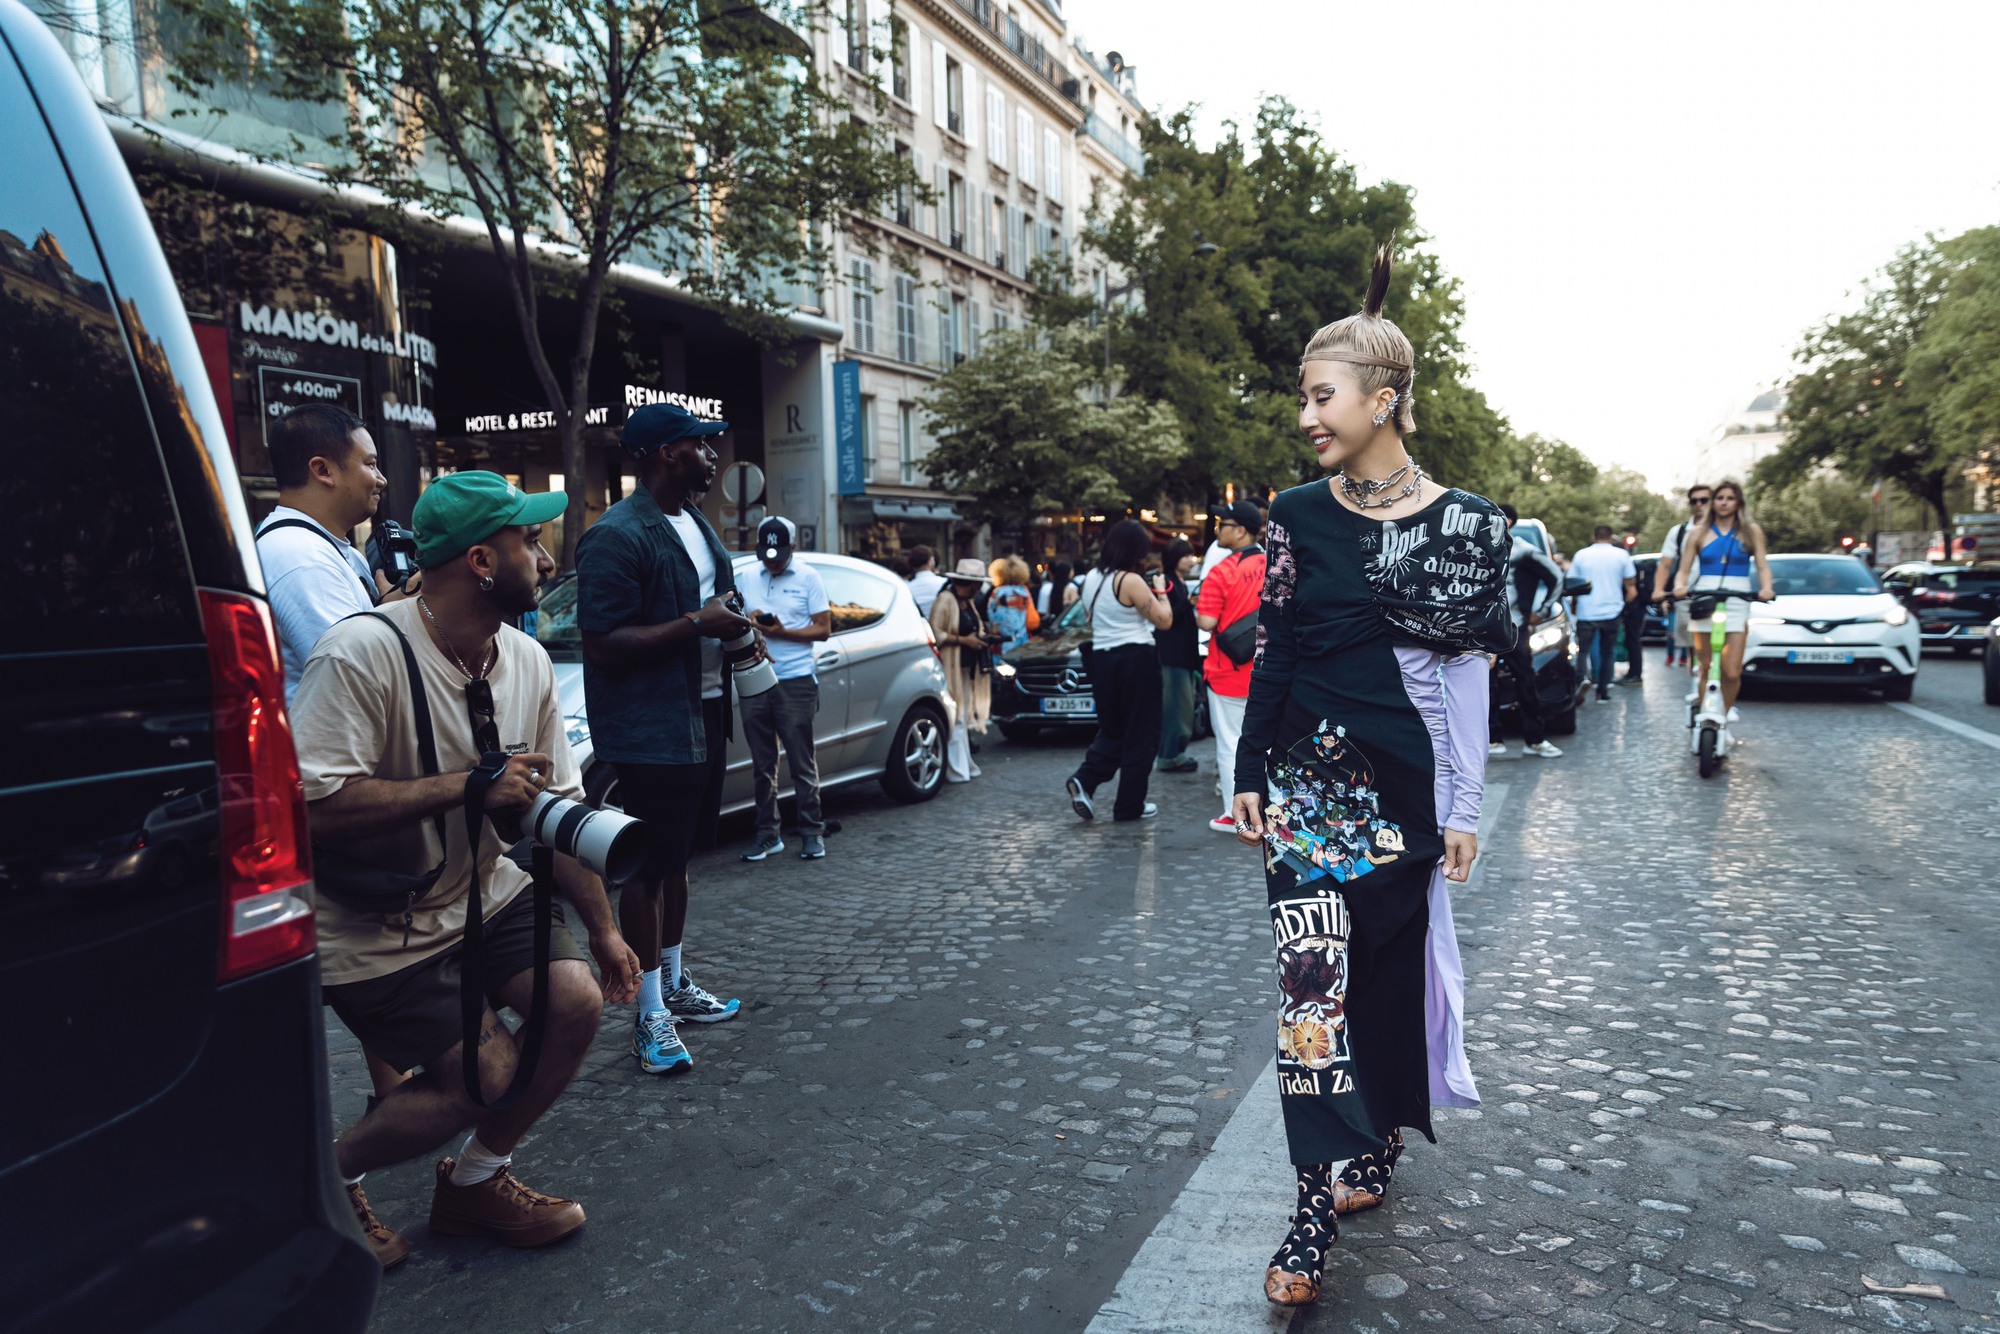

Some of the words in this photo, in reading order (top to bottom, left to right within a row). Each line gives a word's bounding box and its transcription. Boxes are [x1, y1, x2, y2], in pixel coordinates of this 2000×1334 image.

[240, 301, 359, 349] MAISON
[360, 332, 380, 353] de
[380, 335, 394, 355] la
[624, 384, 723, 419] RENAISSANCE
[840, 372, 856, 442] Wagram
[465, 413, 505, 432] HOTEL
[508, 413, 519, 430] &
[786, 403, 804, 433] R
[841, 447, 857, 484] Salle
[1423, 556, 1496, 581] dippin'
[1404, 618, 1422, 631] 1988
[1278, 1071, 1321, 1095] Tidal
[1331, 1069, 1356, 1094] Zo
